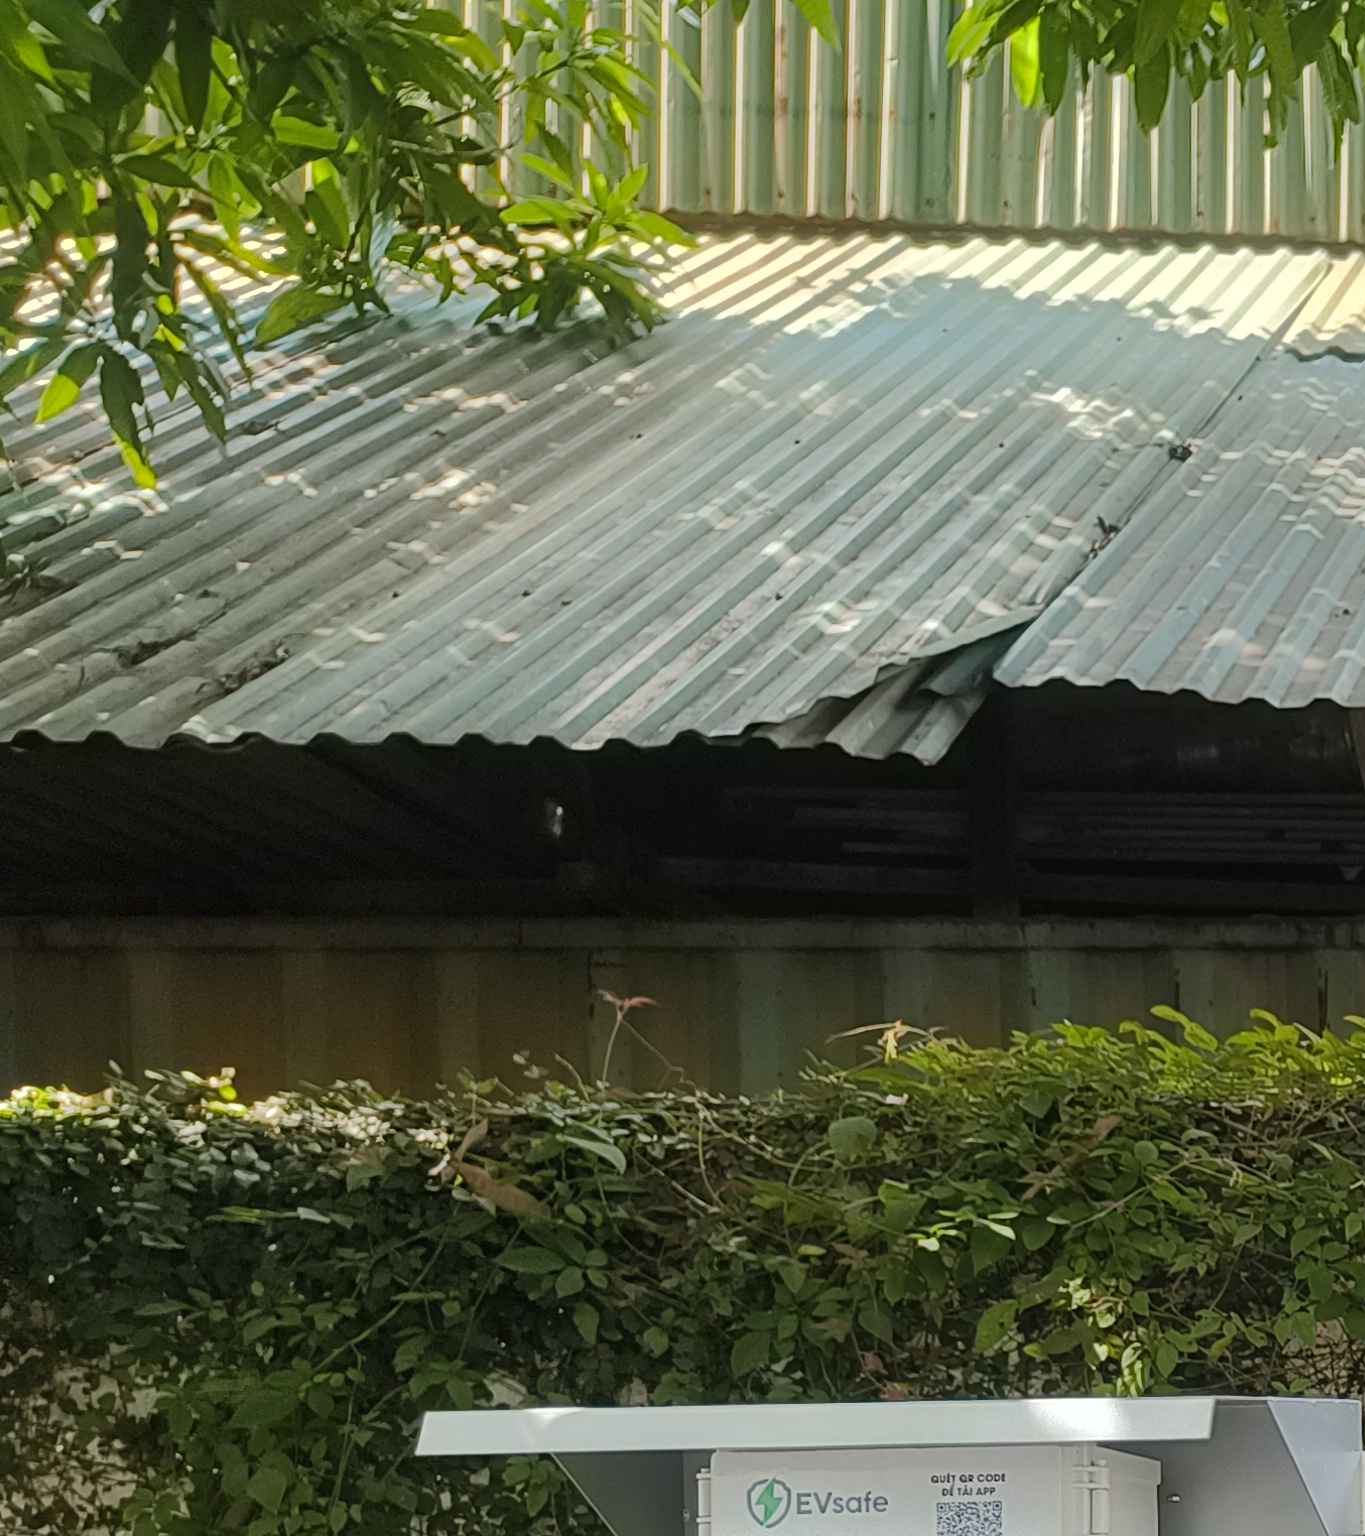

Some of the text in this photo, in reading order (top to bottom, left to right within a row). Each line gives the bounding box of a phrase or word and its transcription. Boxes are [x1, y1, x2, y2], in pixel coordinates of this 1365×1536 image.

[959, 1474, 975, 1484] QR
[977, 1473, 1006, 1483] CODE
[976, 1486, 996, 1496] APP
[795, 1491, 889, 1515] EVsafe
